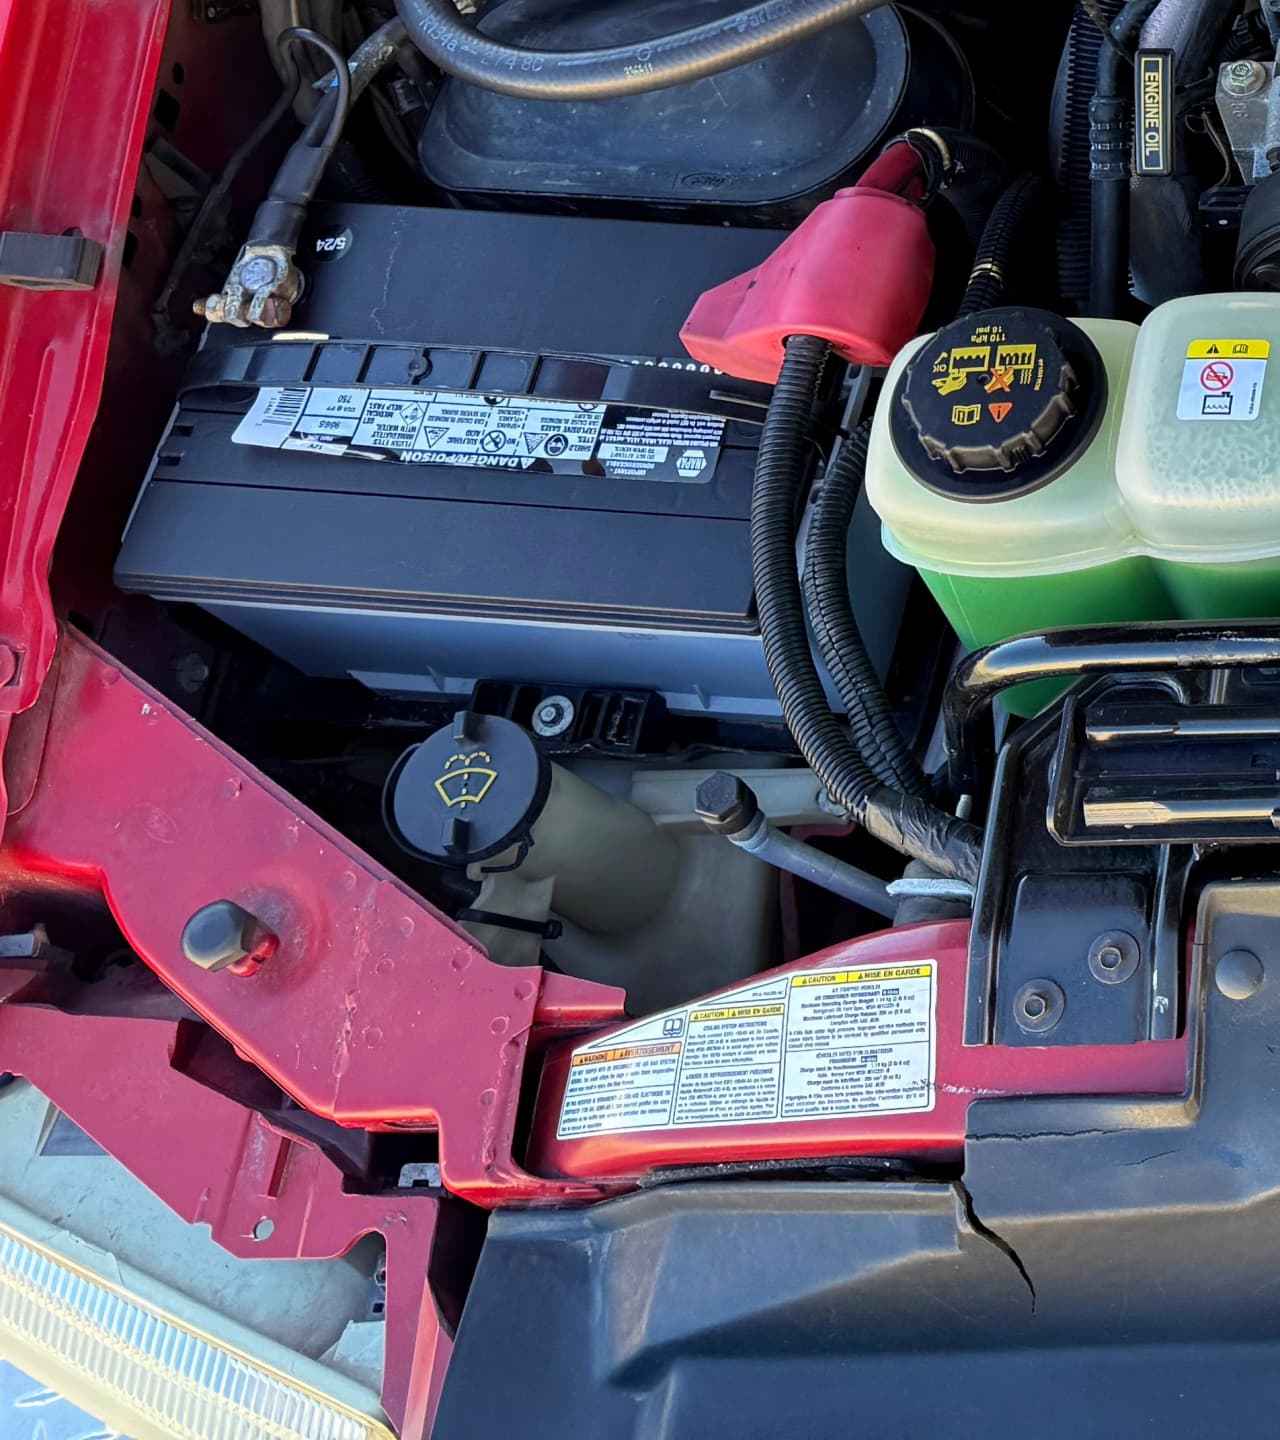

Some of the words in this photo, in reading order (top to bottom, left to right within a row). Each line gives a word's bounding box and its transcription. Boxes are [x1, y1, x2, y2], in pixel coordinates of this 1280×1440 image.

[418, 15, 459, 53] R134a
[1145, 71, 1160, 128] ENGINE
[1145, 129, 1160, 158] OIL
[316, 237, 347, 252] 5/24
[971, 335, 987, 343] kPa
[990, 334, 1006, 342] 110
[933, 364, 947, 373] OK
[338, 395, 352, 403] 750
[447, 437, 478, 445] SULFURIC
[400, 451, 517, 468] DANGER/POISON
[681, 457, 703, 470] NAPA
[807, 975, 837, 984] CAUTION
[864, 971, 882, 980] MISE
[883, 970, 894, 978] EN
[895, 968, 921, 977] GARDE
[623, 1045, 675, 1059] AVERTISSEMENT
